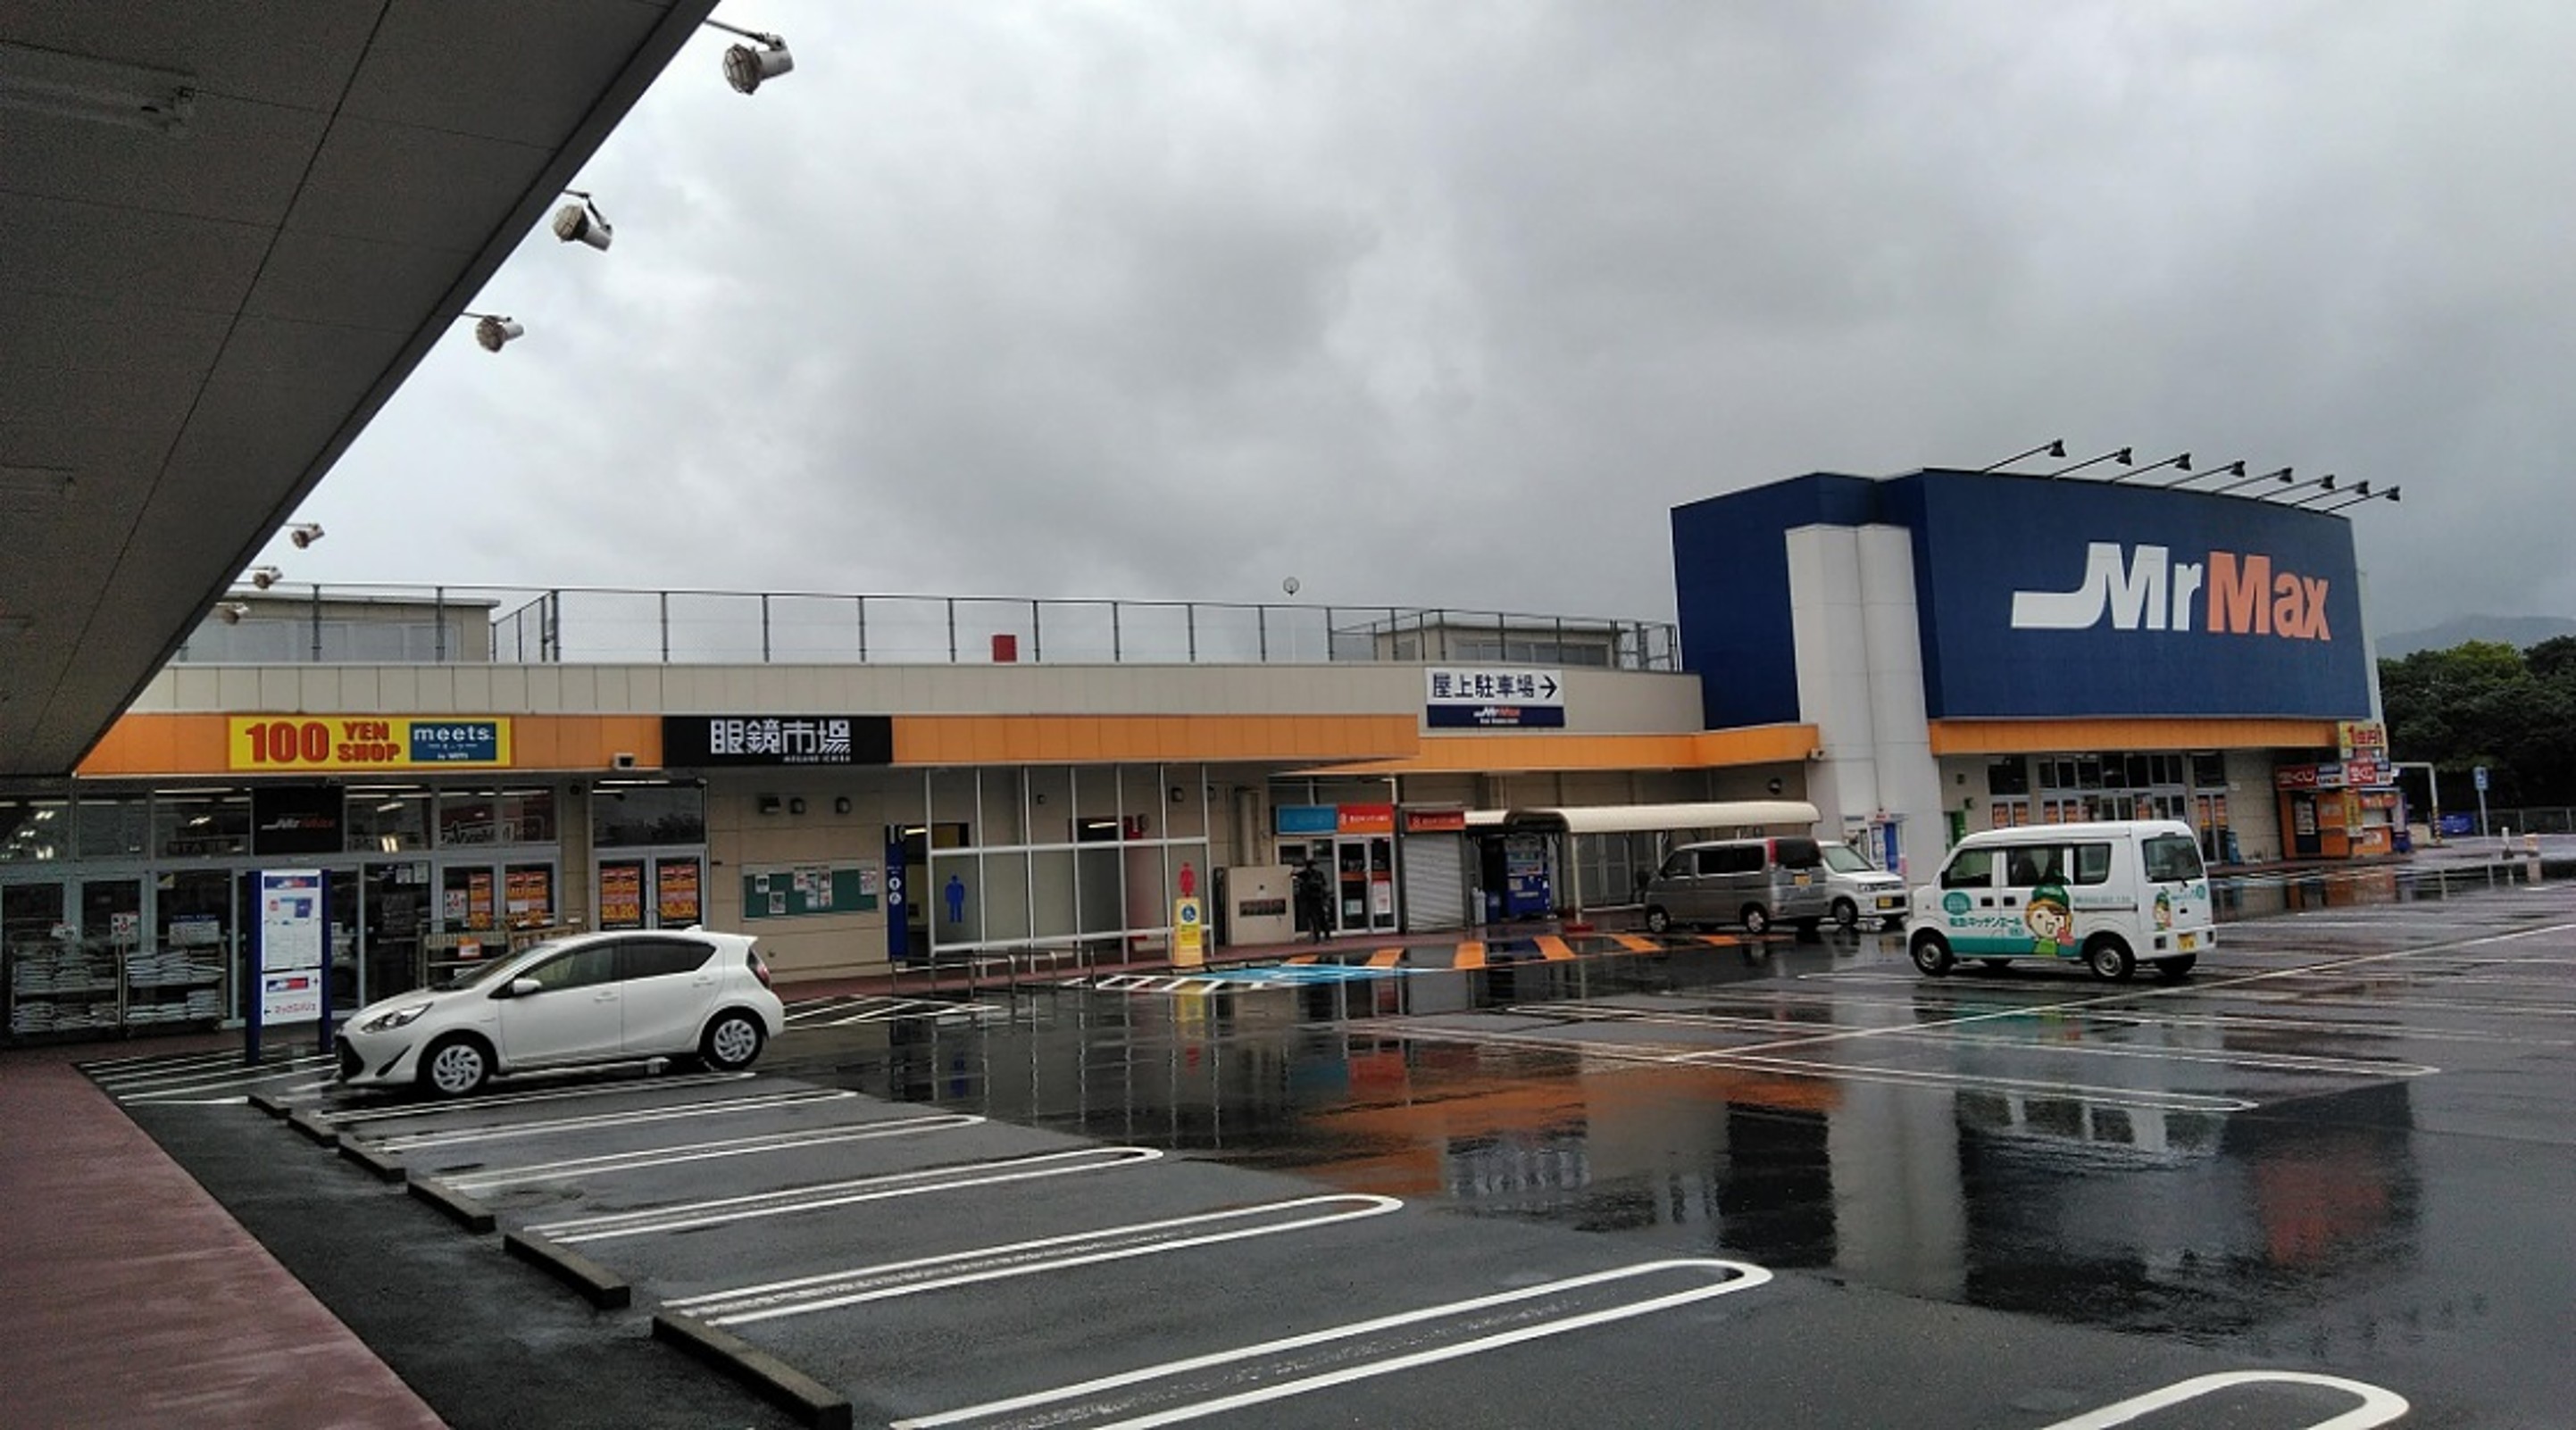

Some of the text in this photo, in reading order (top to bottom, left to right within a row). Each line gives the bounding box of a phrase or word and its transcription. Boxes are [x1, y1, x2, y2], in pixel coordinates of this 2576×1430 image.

[2012, 542, 2331, 641] MrMax
[1433, 672, 1535, 698] 屋上駐車場
[246, 721, 329, 762] 100
[342, 722, 389, 741] YEN
[711, 719, 851, 754] 眼鏡市場
[338, 744, 401, 761] SHOP
